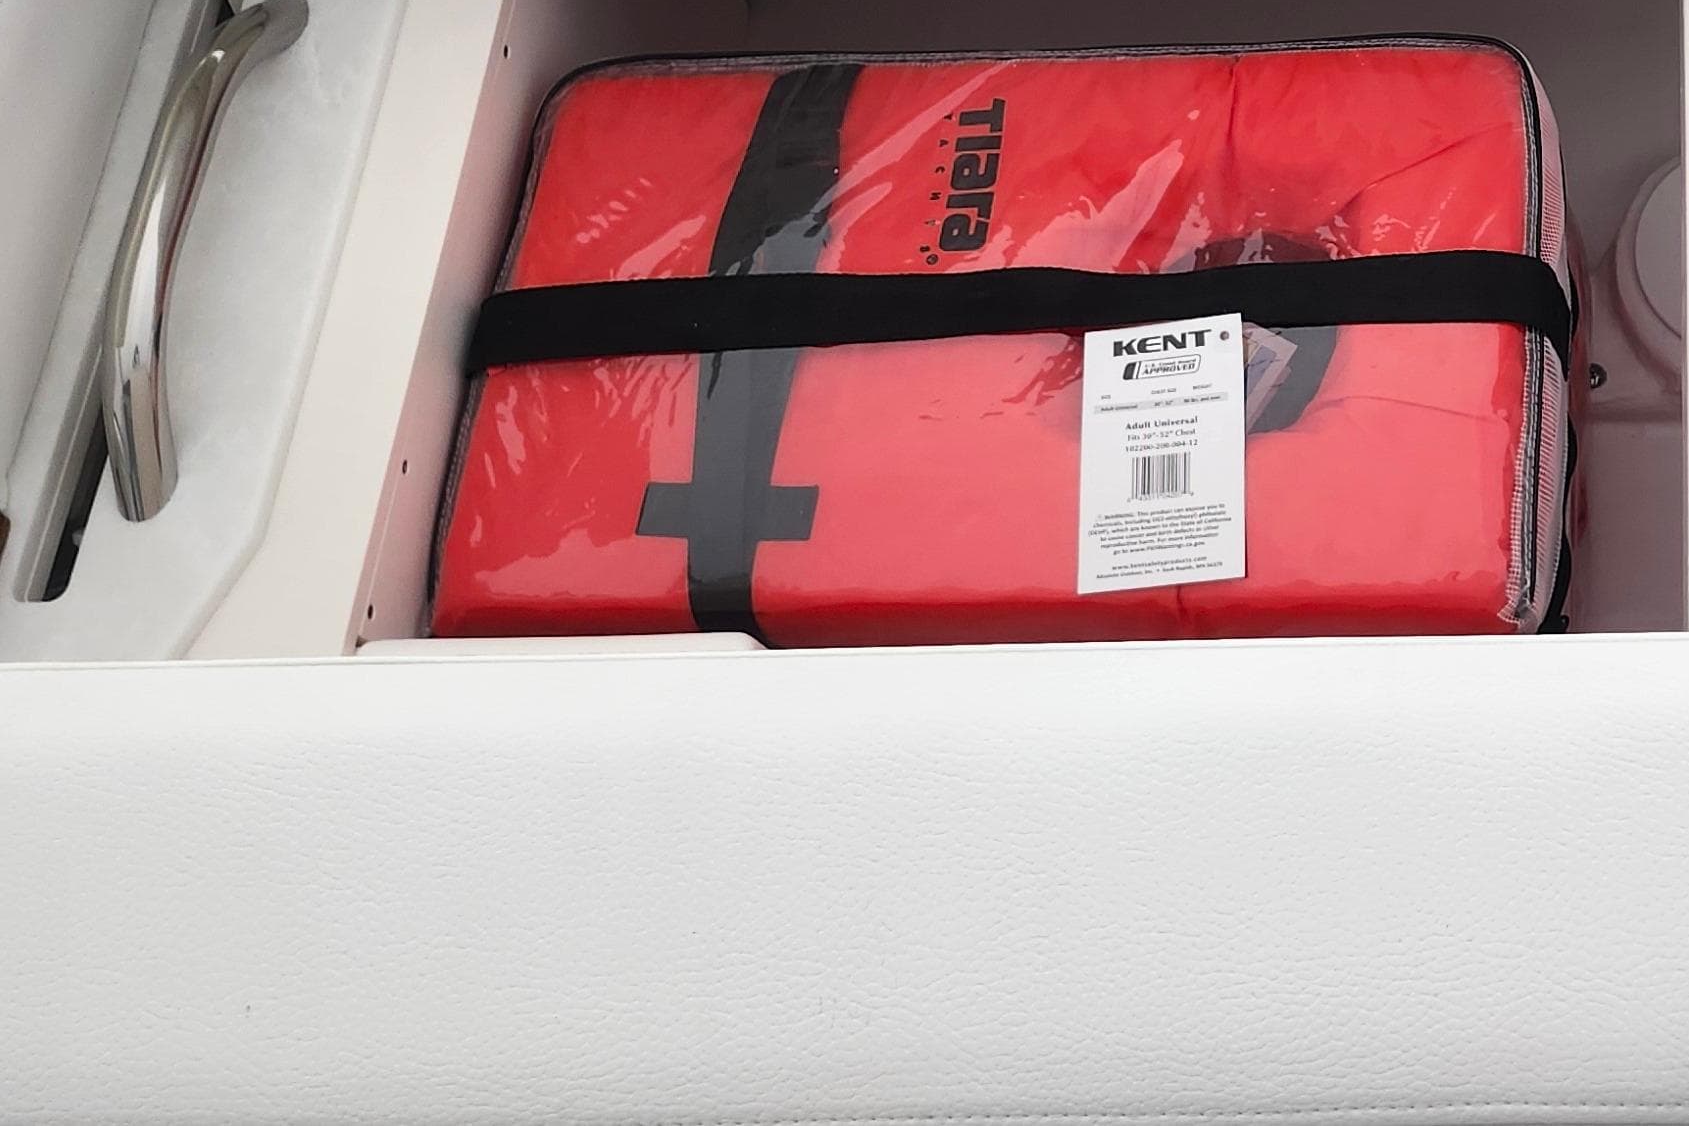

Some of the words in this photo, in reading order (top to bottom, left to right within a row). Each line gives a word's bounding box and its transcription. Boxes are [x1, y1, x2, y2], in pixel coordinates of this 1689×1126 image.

[1113, 329, 1212, 357] KENT
[1142, 362, 1196, 375] APPROVED
[1124, 419, 1151, 429] Adult
[1154, 415, 1198, 427] Universal
